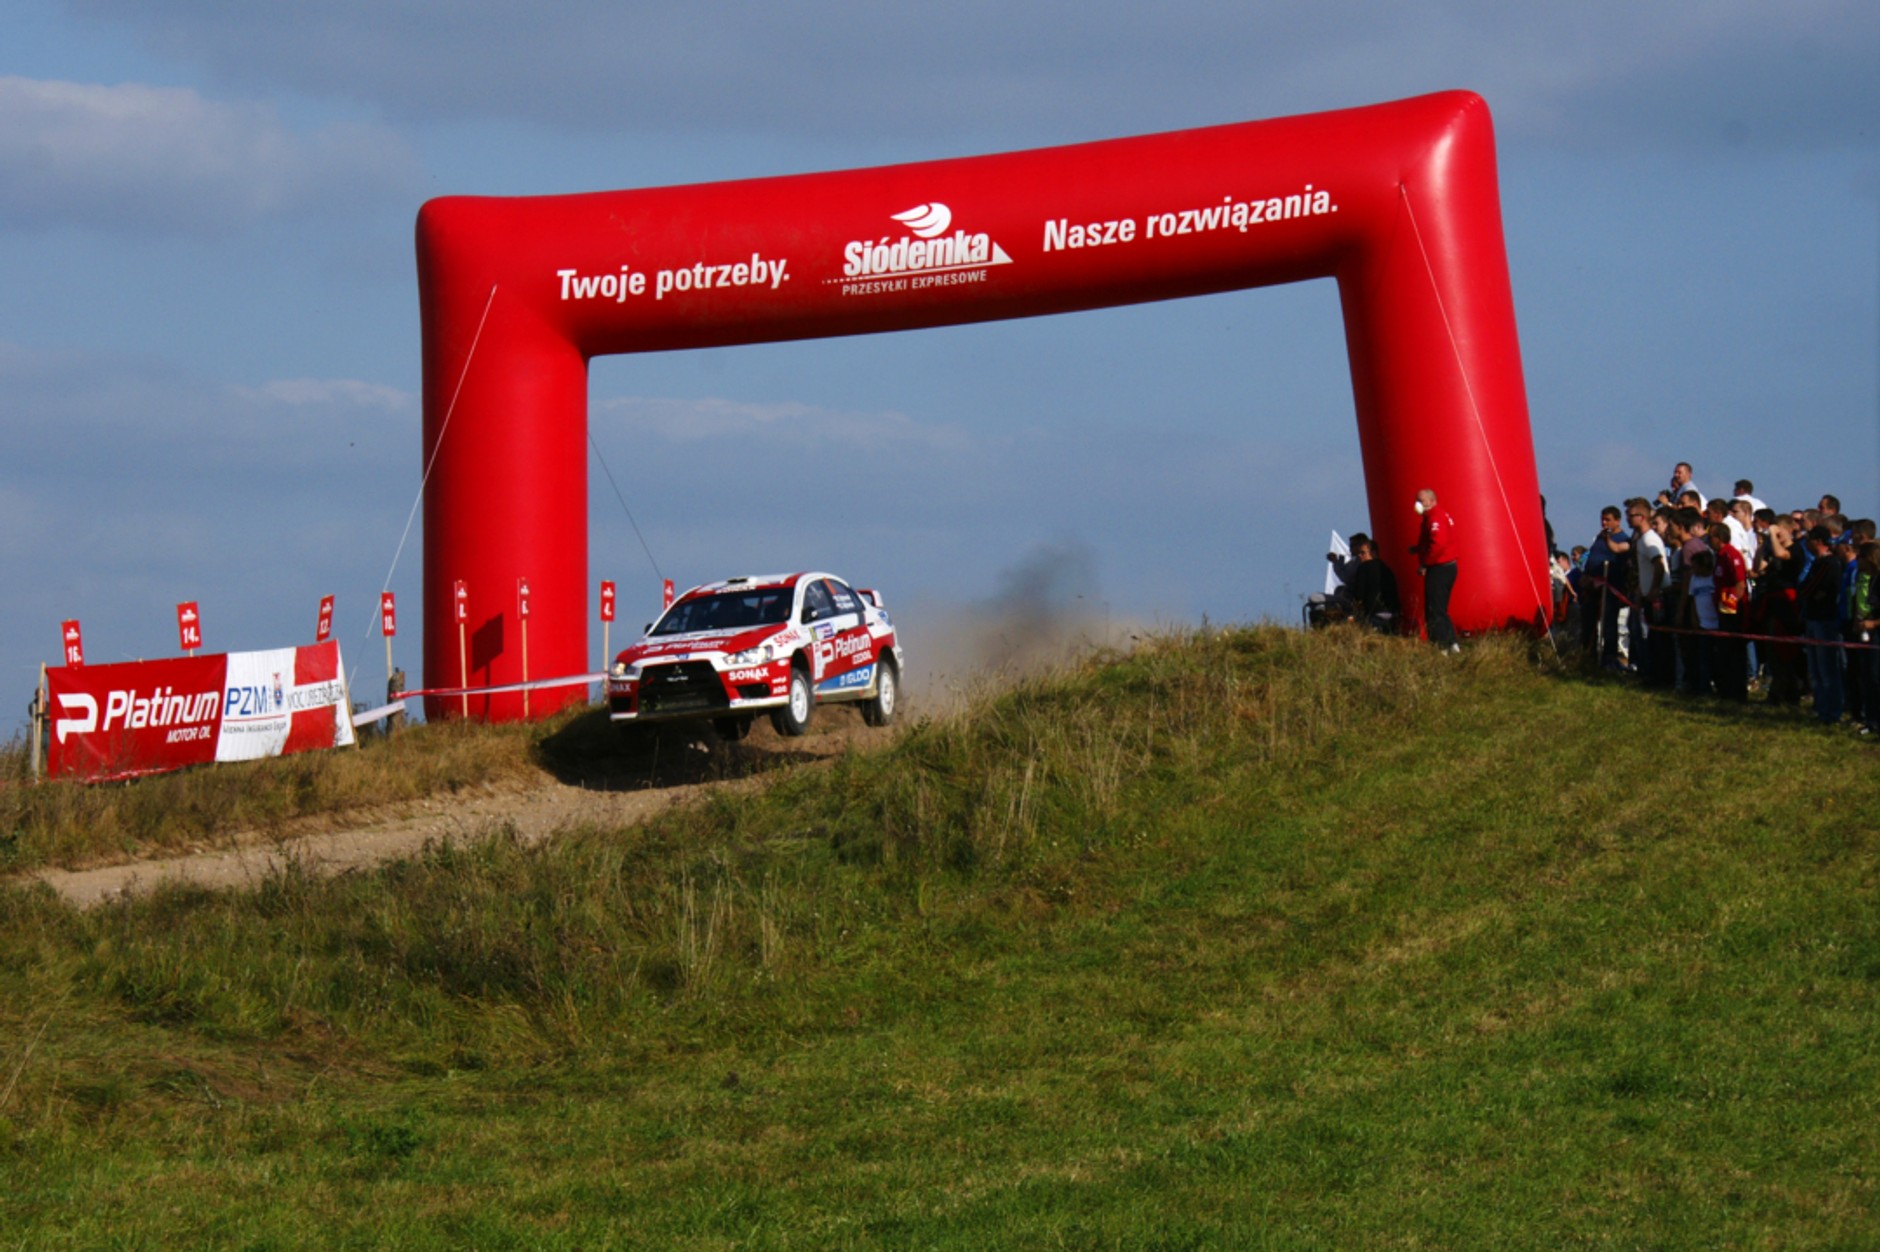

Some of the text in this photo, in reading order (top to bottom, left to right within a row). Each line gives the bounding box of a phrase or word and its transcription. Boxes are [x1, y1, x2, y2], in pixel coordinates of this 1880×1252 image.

[1043, 185, 1338, 252] Nasze rozwiązania.
[843, 230, 990, 276] Siódemka
[556, 252, 791, 304] Twoje potrzeby.
[842, 270, 988, 297] PRZESYŁKI EXPRESOWE
[834, 633, 872, 660] Platinum
[728, 667, 770, 681] SONAX
[102, 685, 221, 732] Platinum
[224, 686, 268, 716] PZM
[165, 725, 212, 743] MOTOR OIL
